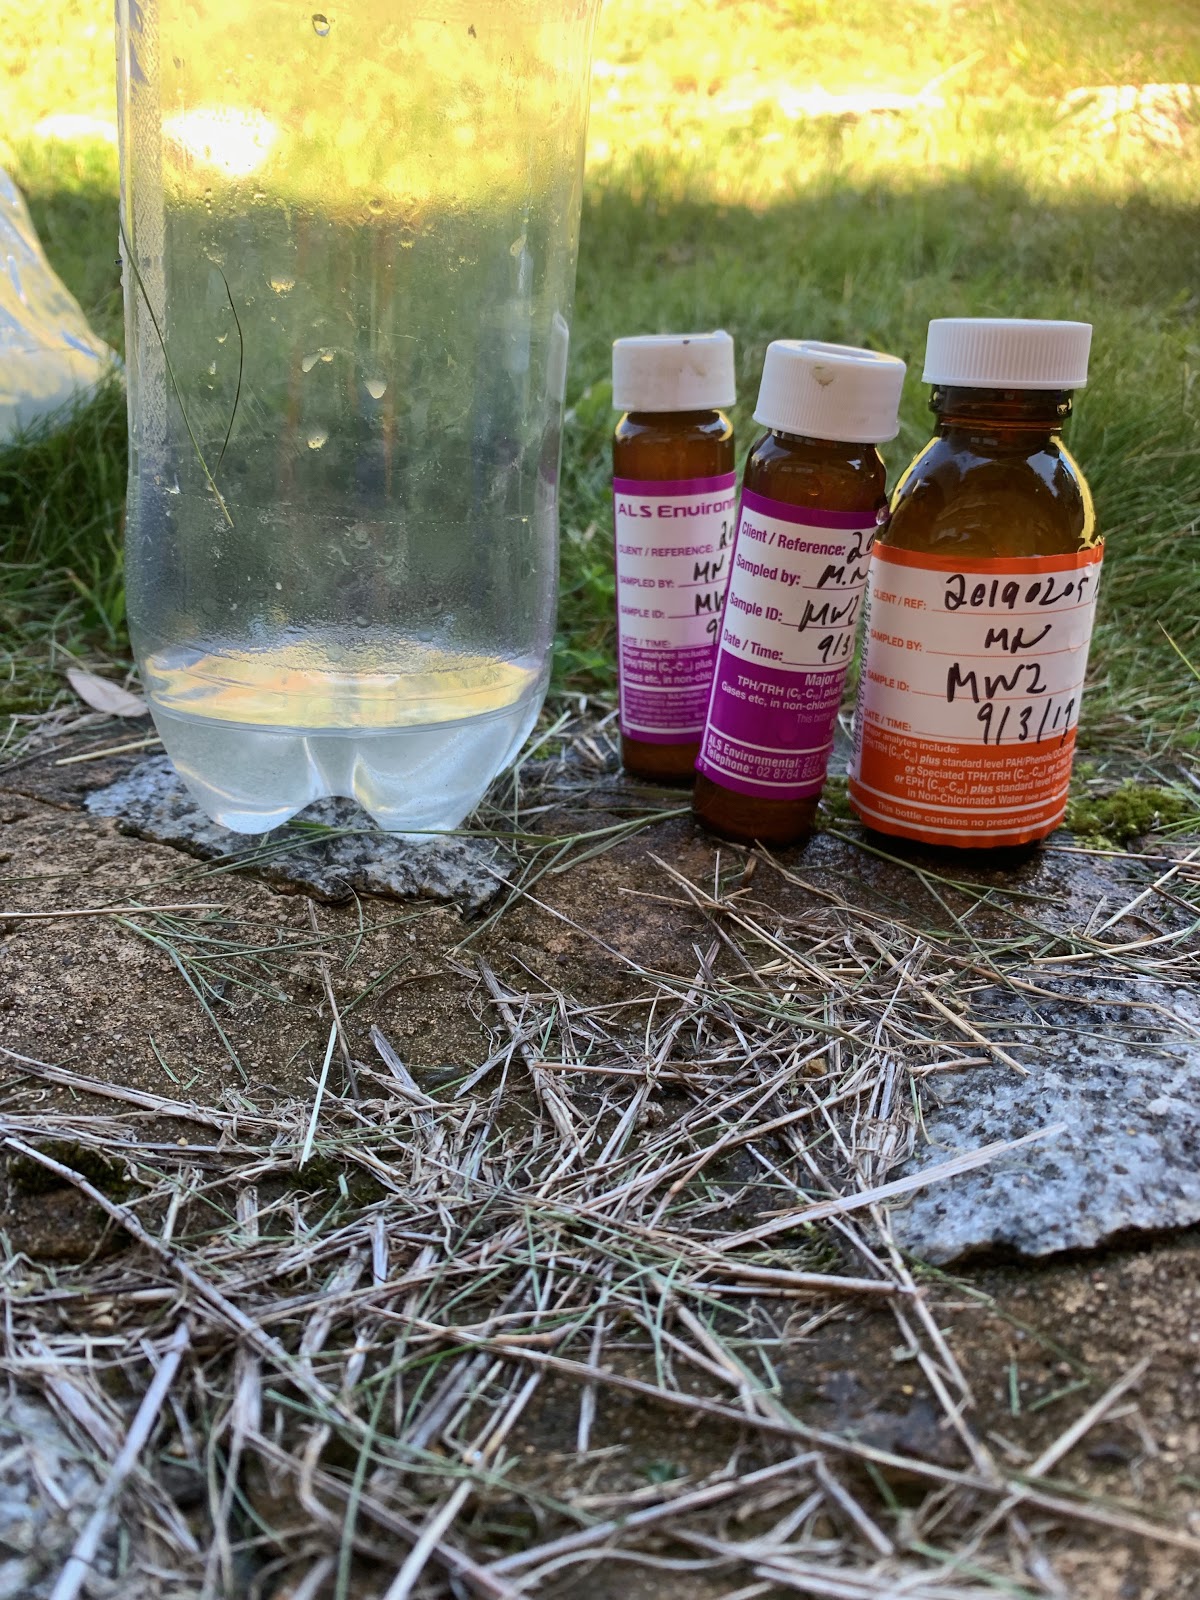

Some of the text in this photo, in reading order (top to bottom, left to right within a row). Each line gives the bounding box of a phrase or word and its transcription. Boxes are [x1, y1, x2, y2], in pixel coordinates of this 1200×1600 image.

[618, 503, 652, 518] ALS
[741, 520, 847, 556] Client / Reference:
[651, 544, 714, 557] REFERENCE:
[736, 553, 801, 587] Sampled by:
[658, 579, 675, 589] BY:
[729, 592, 783, 622] Sample ID:
[873, 588, 897, 605] CLIENT
[904, 598, 927, 611] REF:
[652, 609, 665, 620] ID:
[645, 639, 672, 649] TIME:
[723, 628, 784, 661] Date / Time:
[870, 629, 923, 652] SAMPLED BY:
[984, 624, 1052, 654] MN
[695, 659, 713, 670] plus
[663, 675, 672, 684] in
[737, 675, 784, 698] TPH/TRH
[805, 673, 833, 688] Major
[867, 669, 910, 692] SAMPLE ID:
[946, 662, 1047, 703] MW2
[721, 681, 747, 700] Gases
[770, 699, 780, 709] in
[864, 708, 880, 724] DATE
[886, 715, 912, 733] TIME:
[708, 734, 722, 750] ALS
[723, 744, 802, 769] Environmental:
[883, 733, 917, 748] analytes
[920, 742, 960, 754] include:
[706, 744, 753, 775] Telephone:
[756, 766, 770, 778] 02
[773, 768, 799, 780] 8784
[920, 753, 941, 766] plus
[942, 758, 981, 769] standard
[984, 759, 1004, 769] level
[894, 774, 904, 783] or
[905, 775, 925, 788] EPH
[927, 777, 968, 795] (C10-C40)
[971, 784, 994, 794] plus
[996, 781, 1034, 793] standard
[1035, 775, 1052, 786] level
[905, 765, 915, 775] or
[917, 766, 965, 780] Speciated
[967, 770, 1011, 781] TPH/TRH
[918, 789, 996, 805] Non-Chlorinated
[998, 794, 1023, 804] Water
[877, 800, 893, 813] This
[896, 807, 922, 819] bottle
[925, 815, 968, 826] contains
[986, 811, 1044, 828] preservatives
